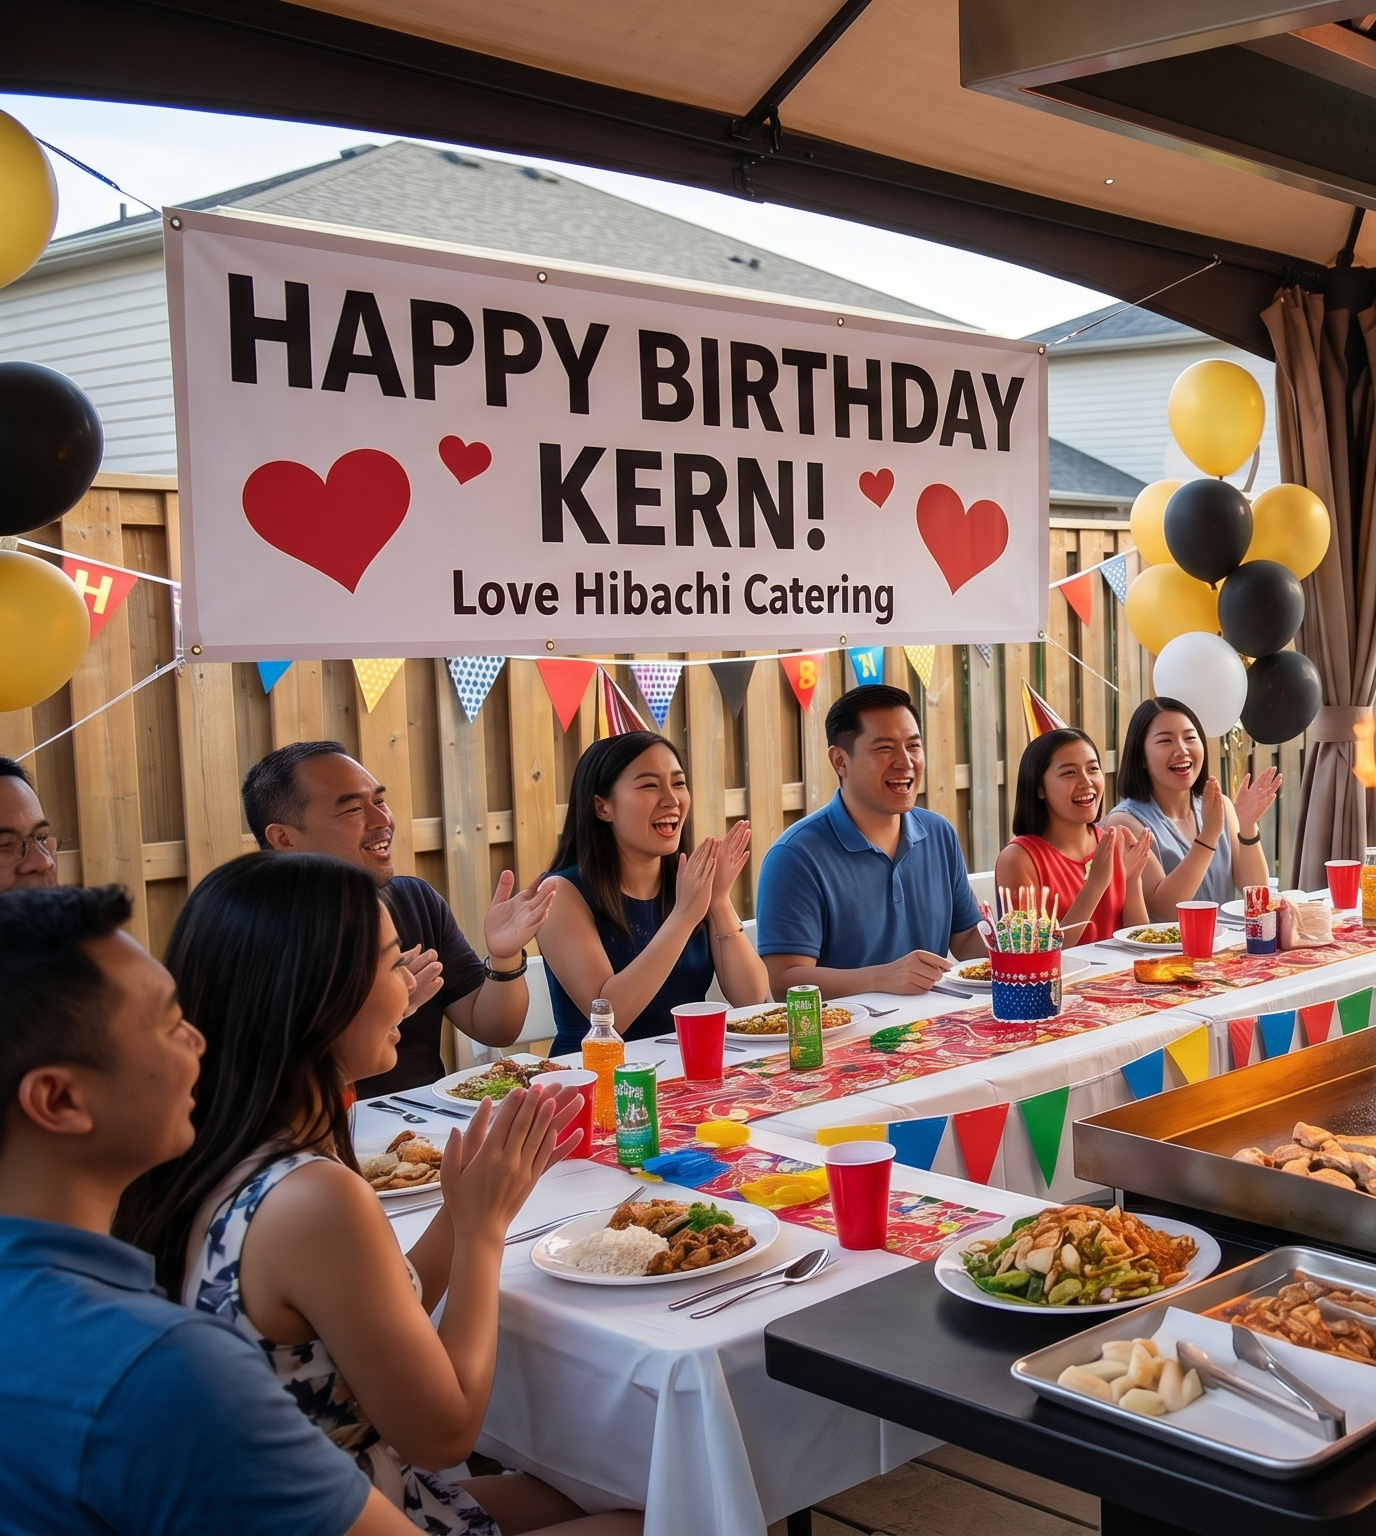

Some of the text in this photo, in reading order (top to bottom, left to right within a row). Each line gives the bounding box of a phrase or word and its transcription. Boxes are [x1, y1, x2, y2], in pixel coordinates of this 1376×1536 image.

[227, 272, 1025, 452] HAPPY BIRTHDAY
[539, 442, 826, 551] KERN!
[453, 569, 895, 625] Love Hibachi Catering
